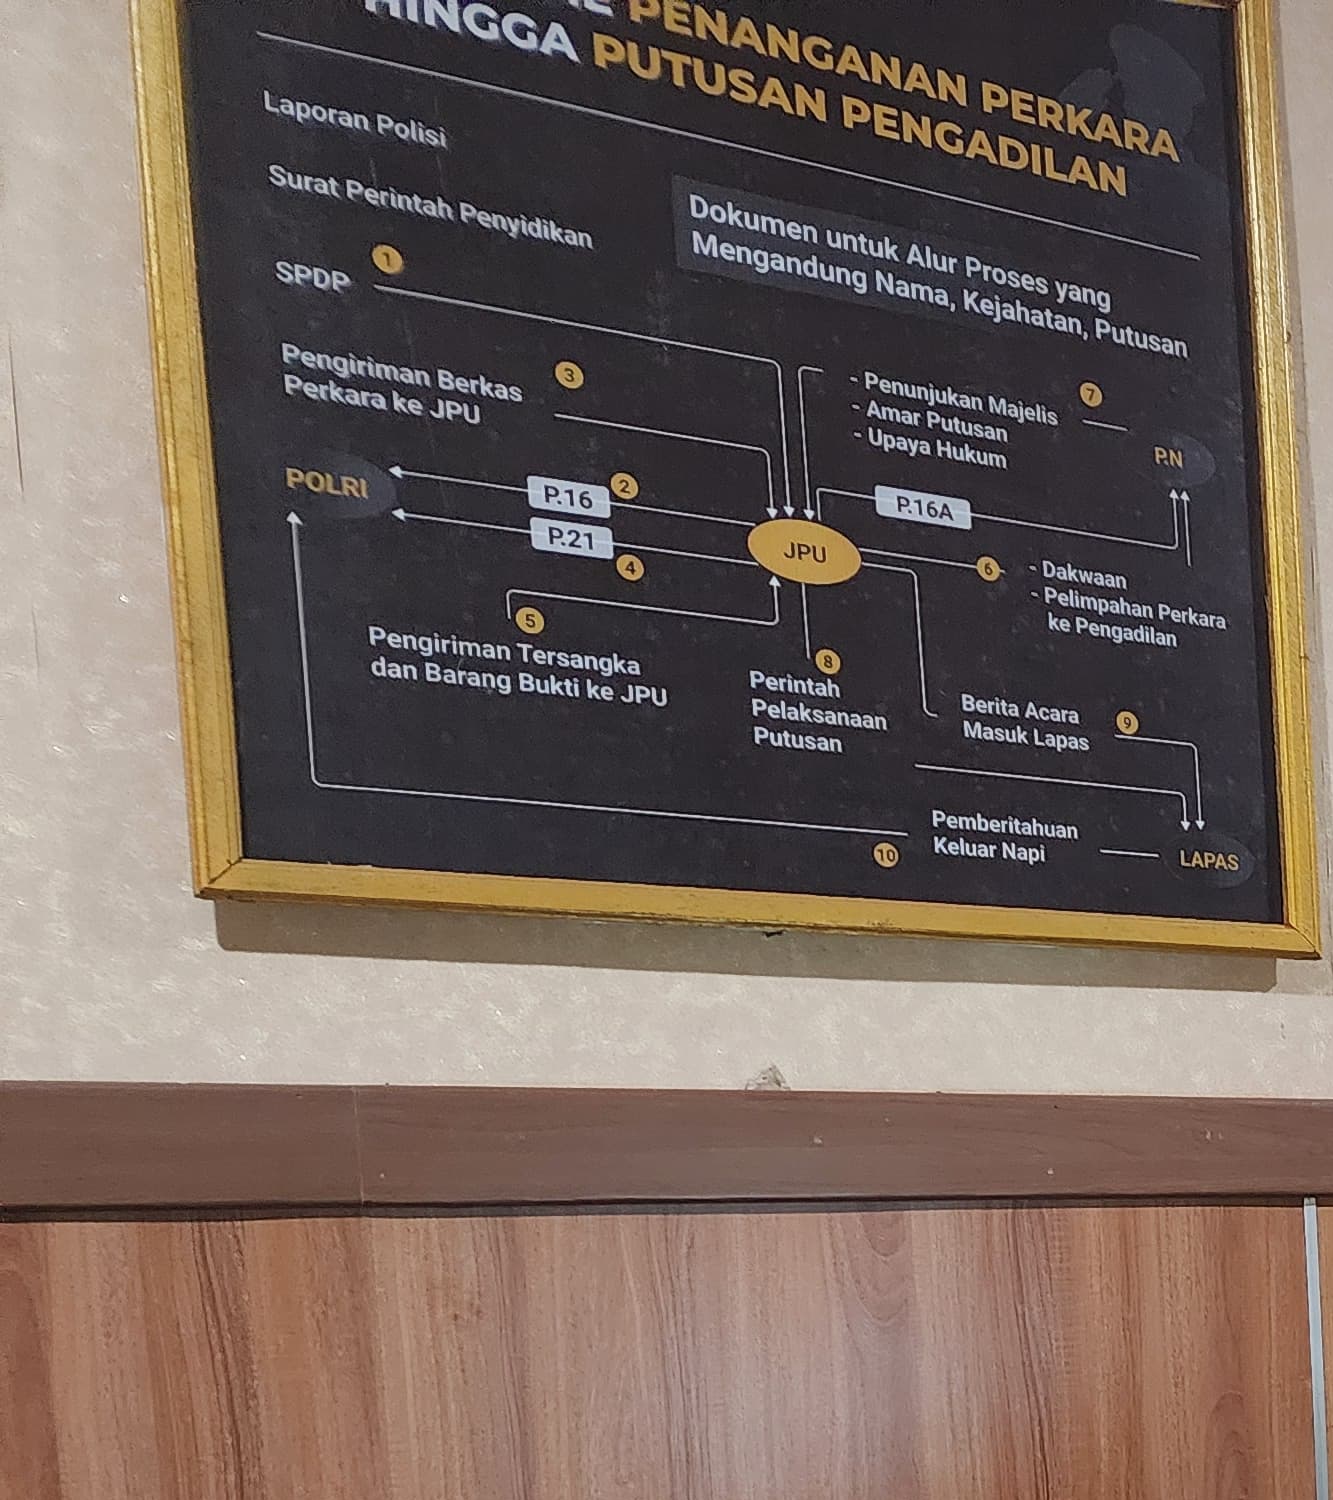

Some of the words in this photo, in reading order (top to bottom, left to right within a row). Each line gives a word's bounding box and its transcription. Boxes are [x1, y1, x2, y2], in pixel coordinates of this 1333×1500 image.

[629, 0, 967, 106] PENANGANAN
[980, 80, 1181, 162] PERKARA
[263, 90, 369, 131] Laporan
[377, 114, 447, 148] Polisi
[592, 31, 827, 122] PUTUSAN
[842, 95, 1127, 196] PENGADILAN
[268, 164, 340, 198] Surat
[346, 180, 454, 222] Perintah
[460, 203, 593, 249] Penyidikan
[689, 194, 817, 243] Dokumen
[827, 225, 899, 261] untuk
[907, 242, 957, 275] Alur
[966, 256, 1048, 294] Proses
[1055, 280, 1111, 312] yang
[275, 261, 351, 293] SPDP
[692, 230, 867, 294] Mengandung
[876, 271, 957, 312] Nama,
[963, 288, 1089, 341] Kejahatan,
[1096, 319, 1189, 359] Putusan
[281, 343, 431, 389] Pengiriman
[438, 368, 523, 402] Berkas
[284, 374, 387, 411] Perkara
[393, 393, 423, 416] ke
[430, 401, 480, 424] JPU
[864, 372, 983, 412] Penunjukan
[989, 398, 1059, 426] Majelis
[867, 401, 922, 426] Amar
[927, 412, 1008, 443] Putusan
[868, 428, 930, 457] Upaya
[937, 440, 1008, 470] Hukum
[1154, 446, 1183, 469] P.N
[286, 467, 367, 499] POLRI
[543, 485, 593, 511] P.16
[896, 496, 954, 522] P.16A
[547, 526, 595, 551] P.21
[783, 541, 828, 565] JPU
[1042, 561, 1128, 590] Dakwaan
[1044, 587, 1153, 622] Pelimpahan
[1158, 602, 1227, 630] Perkara
[1047, 613, 1071, 633] ke
[1076, 616, 1178, 649] Pengadilan
[368, 626, 511, 661] Pengiriman
[516, 643, 641, 677] Tersangka
[371, 657, 418, 682] dan
[425, 664, 512, 695] Barang
[519, 675, 580, 699] Bukti
[587, 679, 614, 703] ke
[620, 683, 668, 707] JPU
[749, 670, 840, 699] Perintah
[751, 698, 888, 731] Pelaksanaan
[961, 694, 1019, 718] Berita
[1025, 702, 1080, 726] Acara
[753, 726, 843, 754] Putusan
[963, 720, 1029, 746] Masuk
[1034, 727, 1090, 752] Lapas
[932, 810, 1079, 841] Pemberitahuan
[876, 846, 896, 864] 10
[933, 837, 996, 859] Keluar
[1002, 842, 1046, 865] Napi
[1180, 849, 1239, 872] LAPAS
